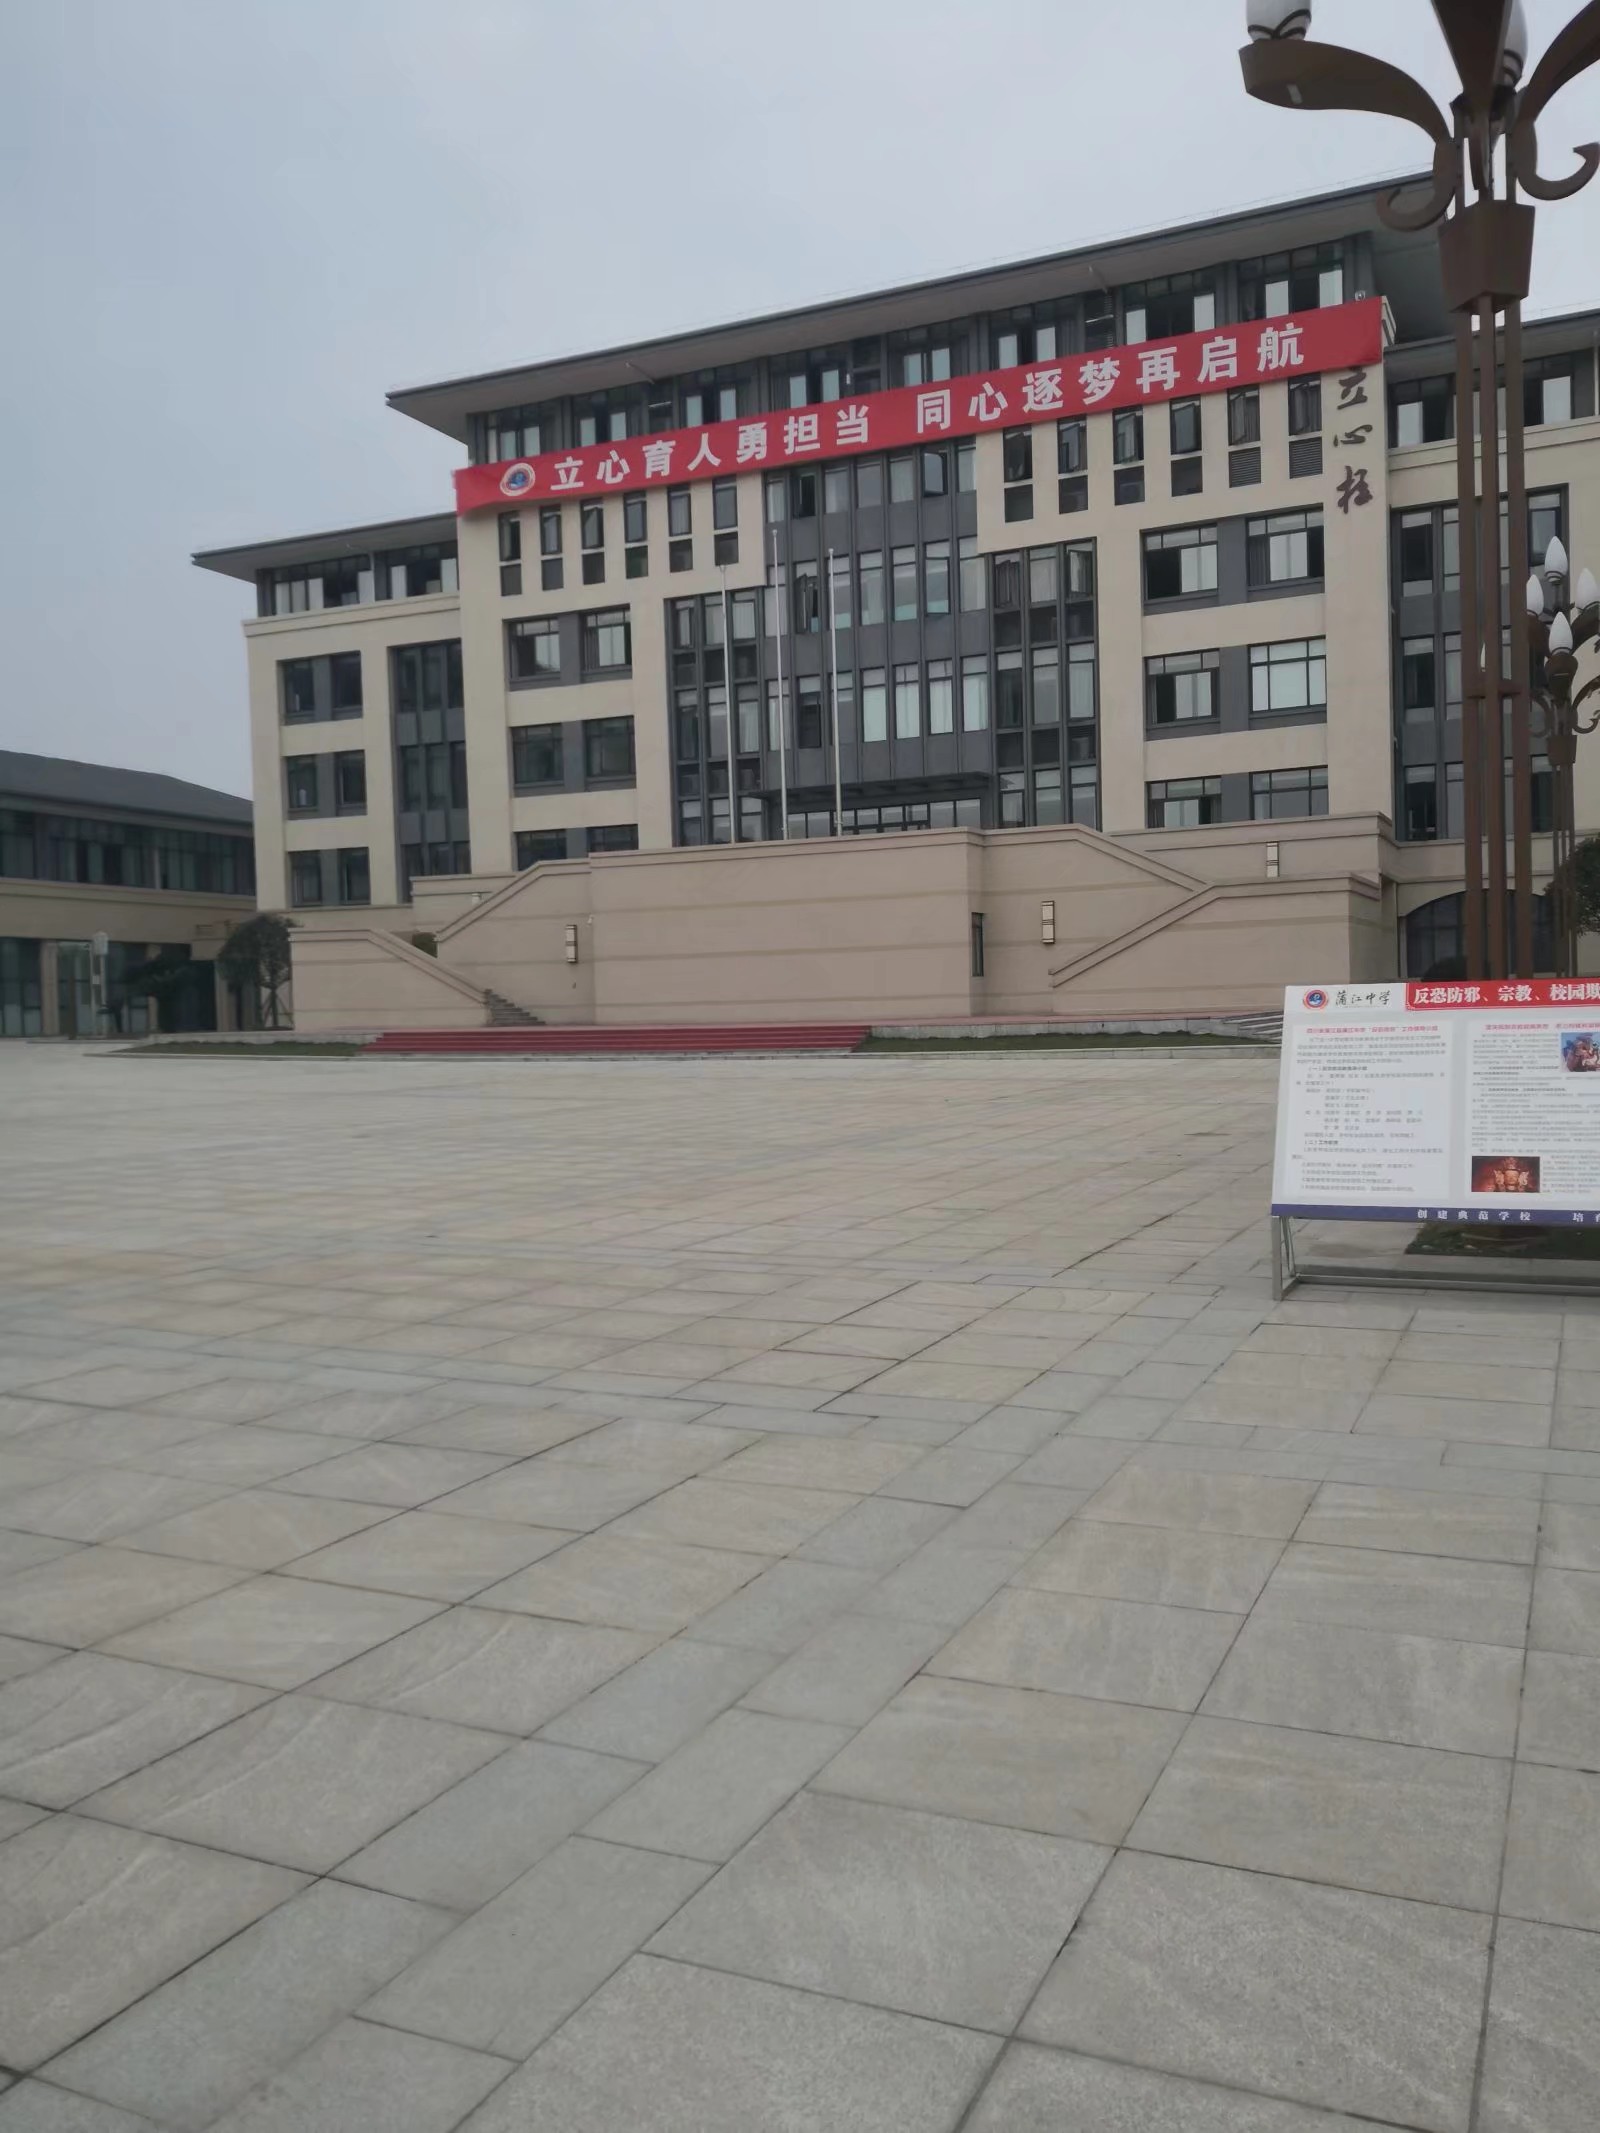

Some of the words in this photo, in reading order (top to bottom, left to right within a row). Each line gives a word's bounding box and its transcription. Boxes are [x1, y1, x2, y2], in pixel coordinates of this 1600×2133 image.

[550, 404, 870, 492] 立心育人勇担当
[916, 321, 1305, 434] 同心逐梦再启航
[1335, 989, 1391, 1006] 蒲江中学
[1417, 1209, 1531, 1221] 创建典范学校
